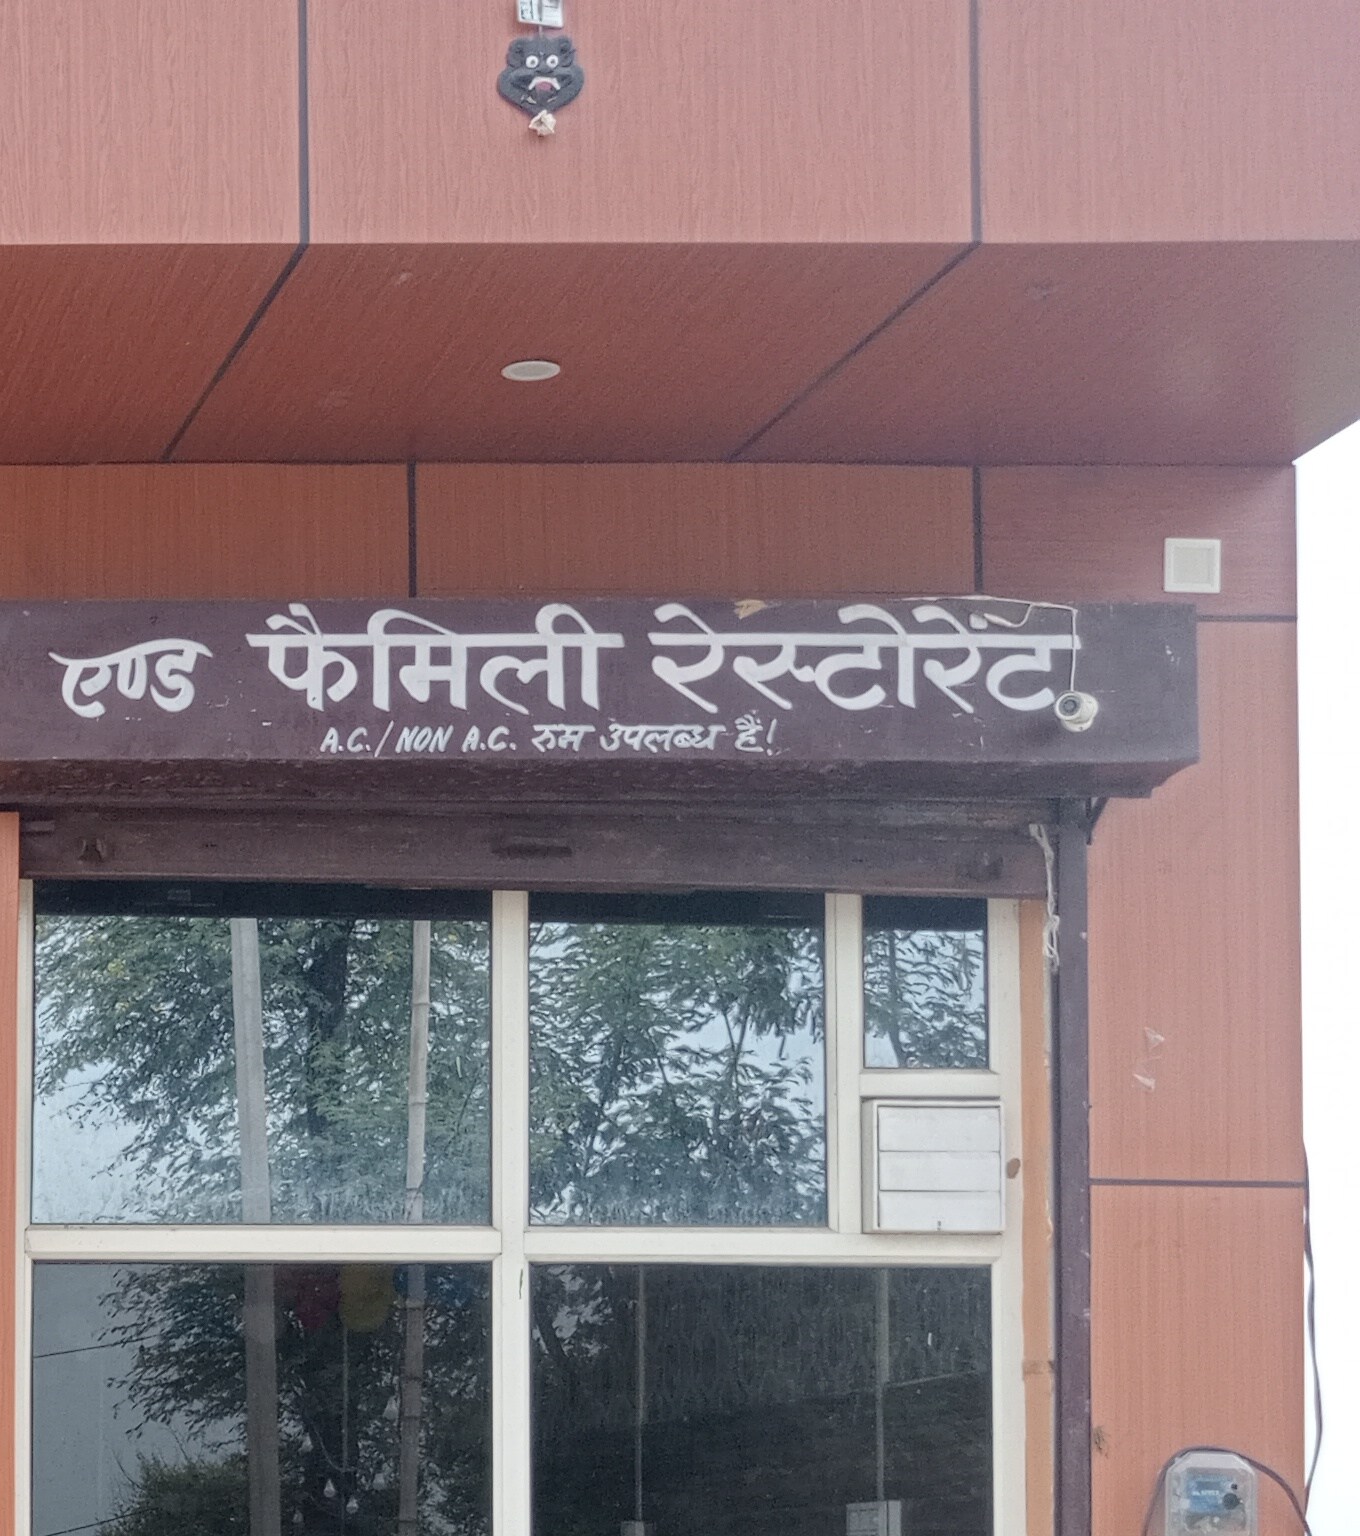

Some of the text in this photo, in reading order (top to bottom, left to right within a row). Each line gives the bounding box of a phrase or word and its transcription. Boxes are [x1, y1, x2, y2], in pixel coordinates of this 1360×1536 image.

[48, 637, 213, 719] एण्ड
[245, 602, 626, 716] फैमिली
[461, 724, 518, 753] A.C.
[599, 722, 727, 753] उपलब्ध
